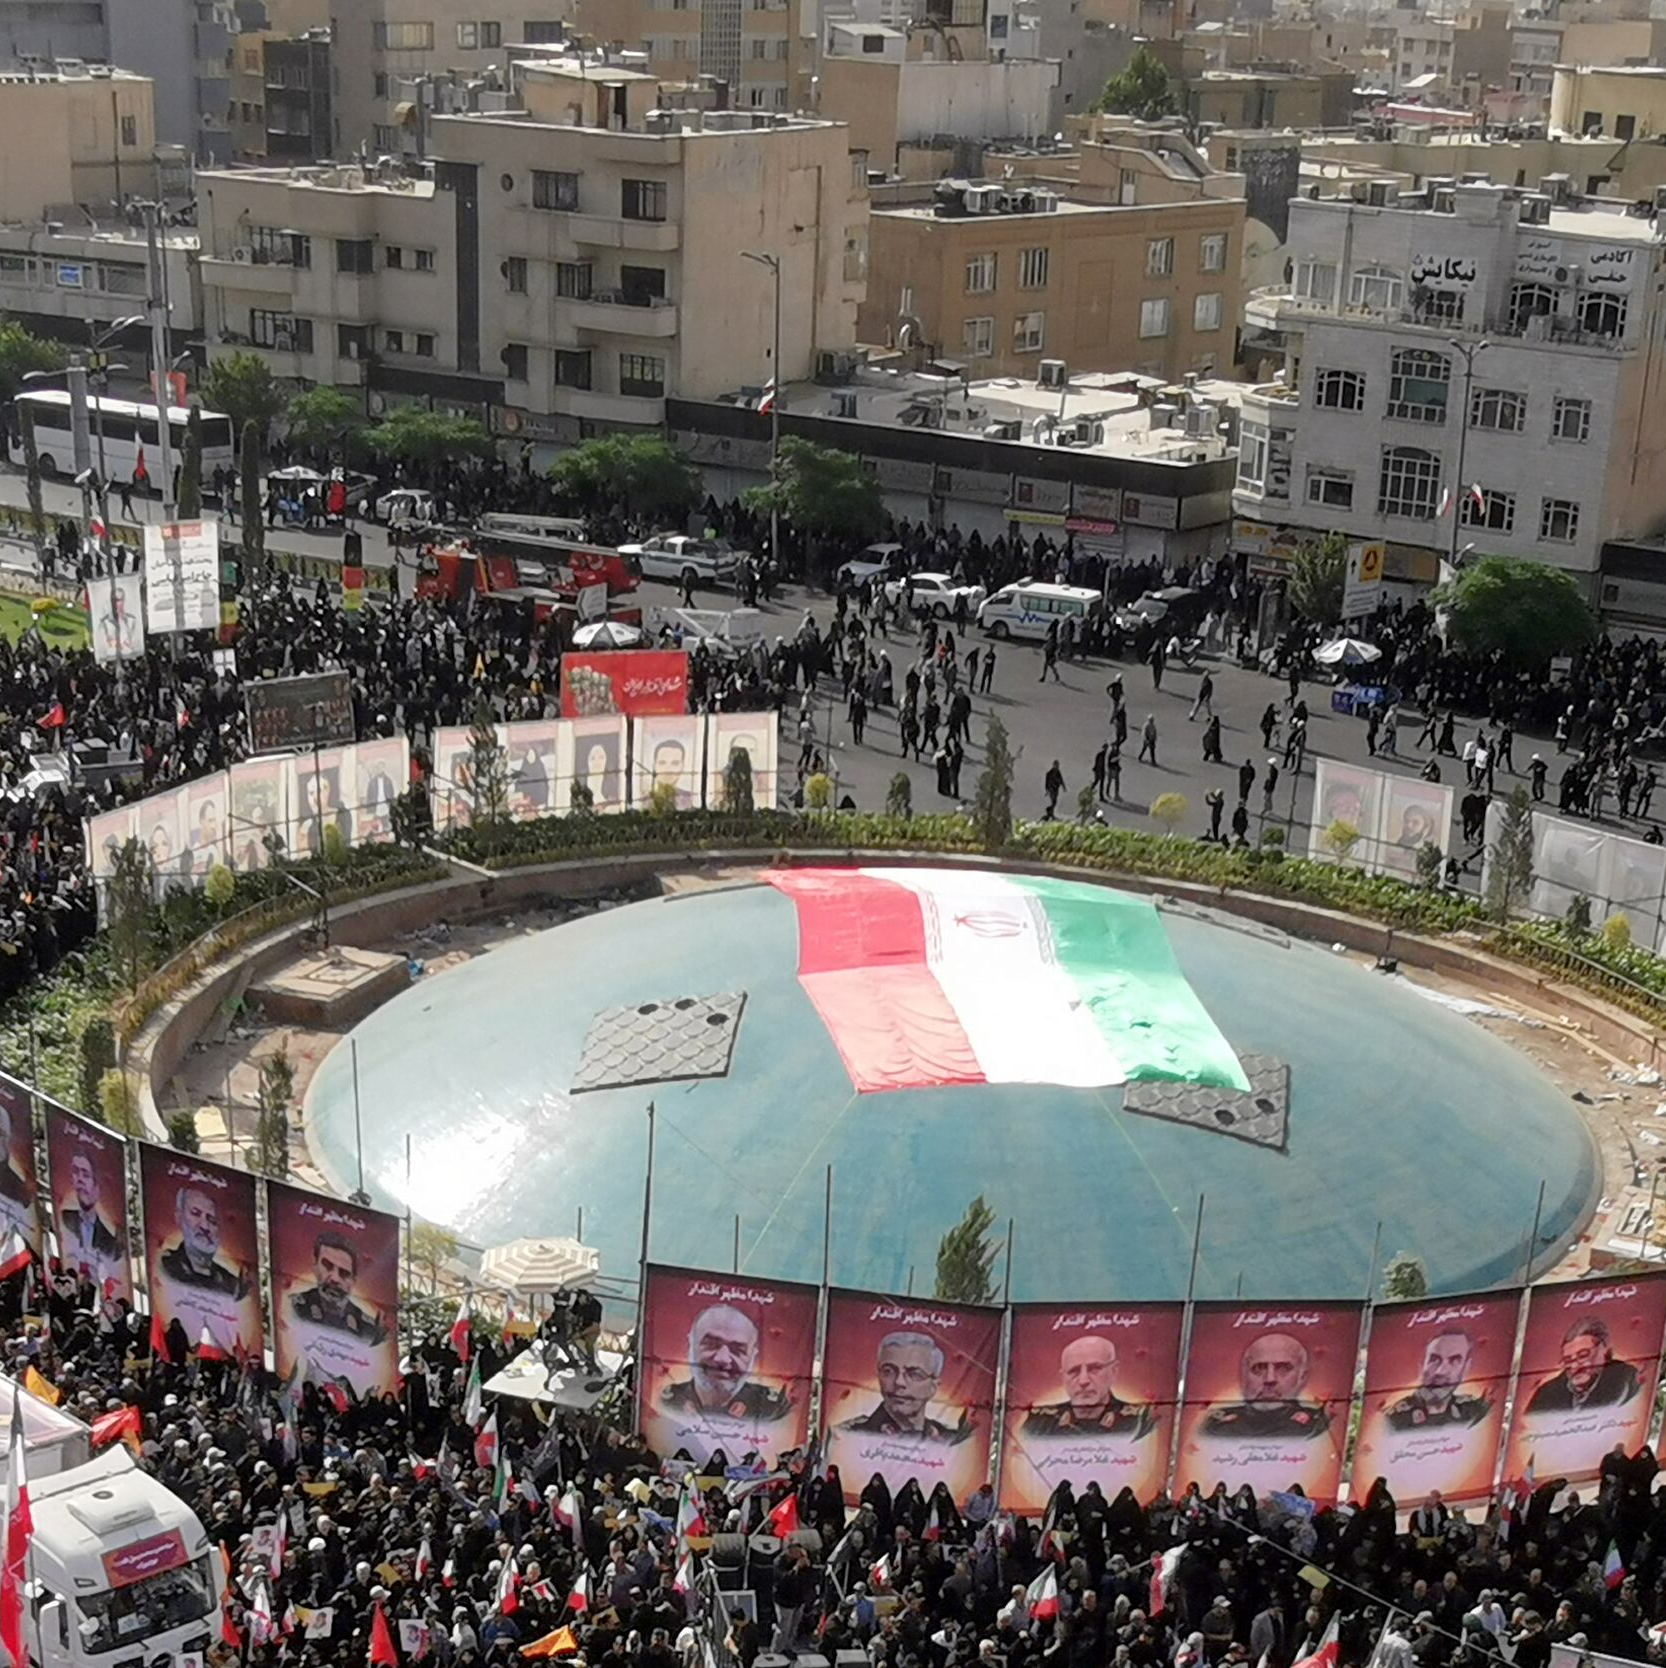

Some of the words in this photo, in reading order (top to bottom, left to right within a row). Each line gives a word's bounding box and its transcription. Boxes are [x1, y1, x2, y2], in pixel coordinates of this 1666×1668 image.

[688, 1281, 727, 1297] اقتدار
[721, 1288, 746, 1301] مظهر
[747, 1289, 775, 1303] شهدا
[1614, 1286, 1638, 1298] شهدا
[1564, 1291, 1593, 1308] اقتدار
[1592, 1290, 1616, 1304] مظهر
[870, 1304, 904, 1320] اقتدار
[903, 1309, 930, 1324] مظهر
[1435, 1309, 1461, 1324] مظهر
[1459, 1304, 1485, 1319] شهدا
[931, 1311, 957, 1327] شهدا
[1053, 1314, 1084, 1330] اقتدار
[1085, 1314, 1112, 1329] مظهر
[1113, 1313, 1139, 1326] شهدا
[1233, 1313, 1265, 1328] اقتدار
[1265, 1313, 1292, 1327] مظهر
[1293, 1311, 1319, 1327] شهدا
[1407, 1311, 1436, 1327] اقتدار
[676, 1425, 710, 1437] سلامی
[711, 1429, 741, 1441] حسین
[743, 1432, 769, 1444] شهید
[1110, 1453, 1137, 1464] شهید
[1212, 1453, 1240, 1466] رشید
[1280, 1452, 1307, 1464] شهید
